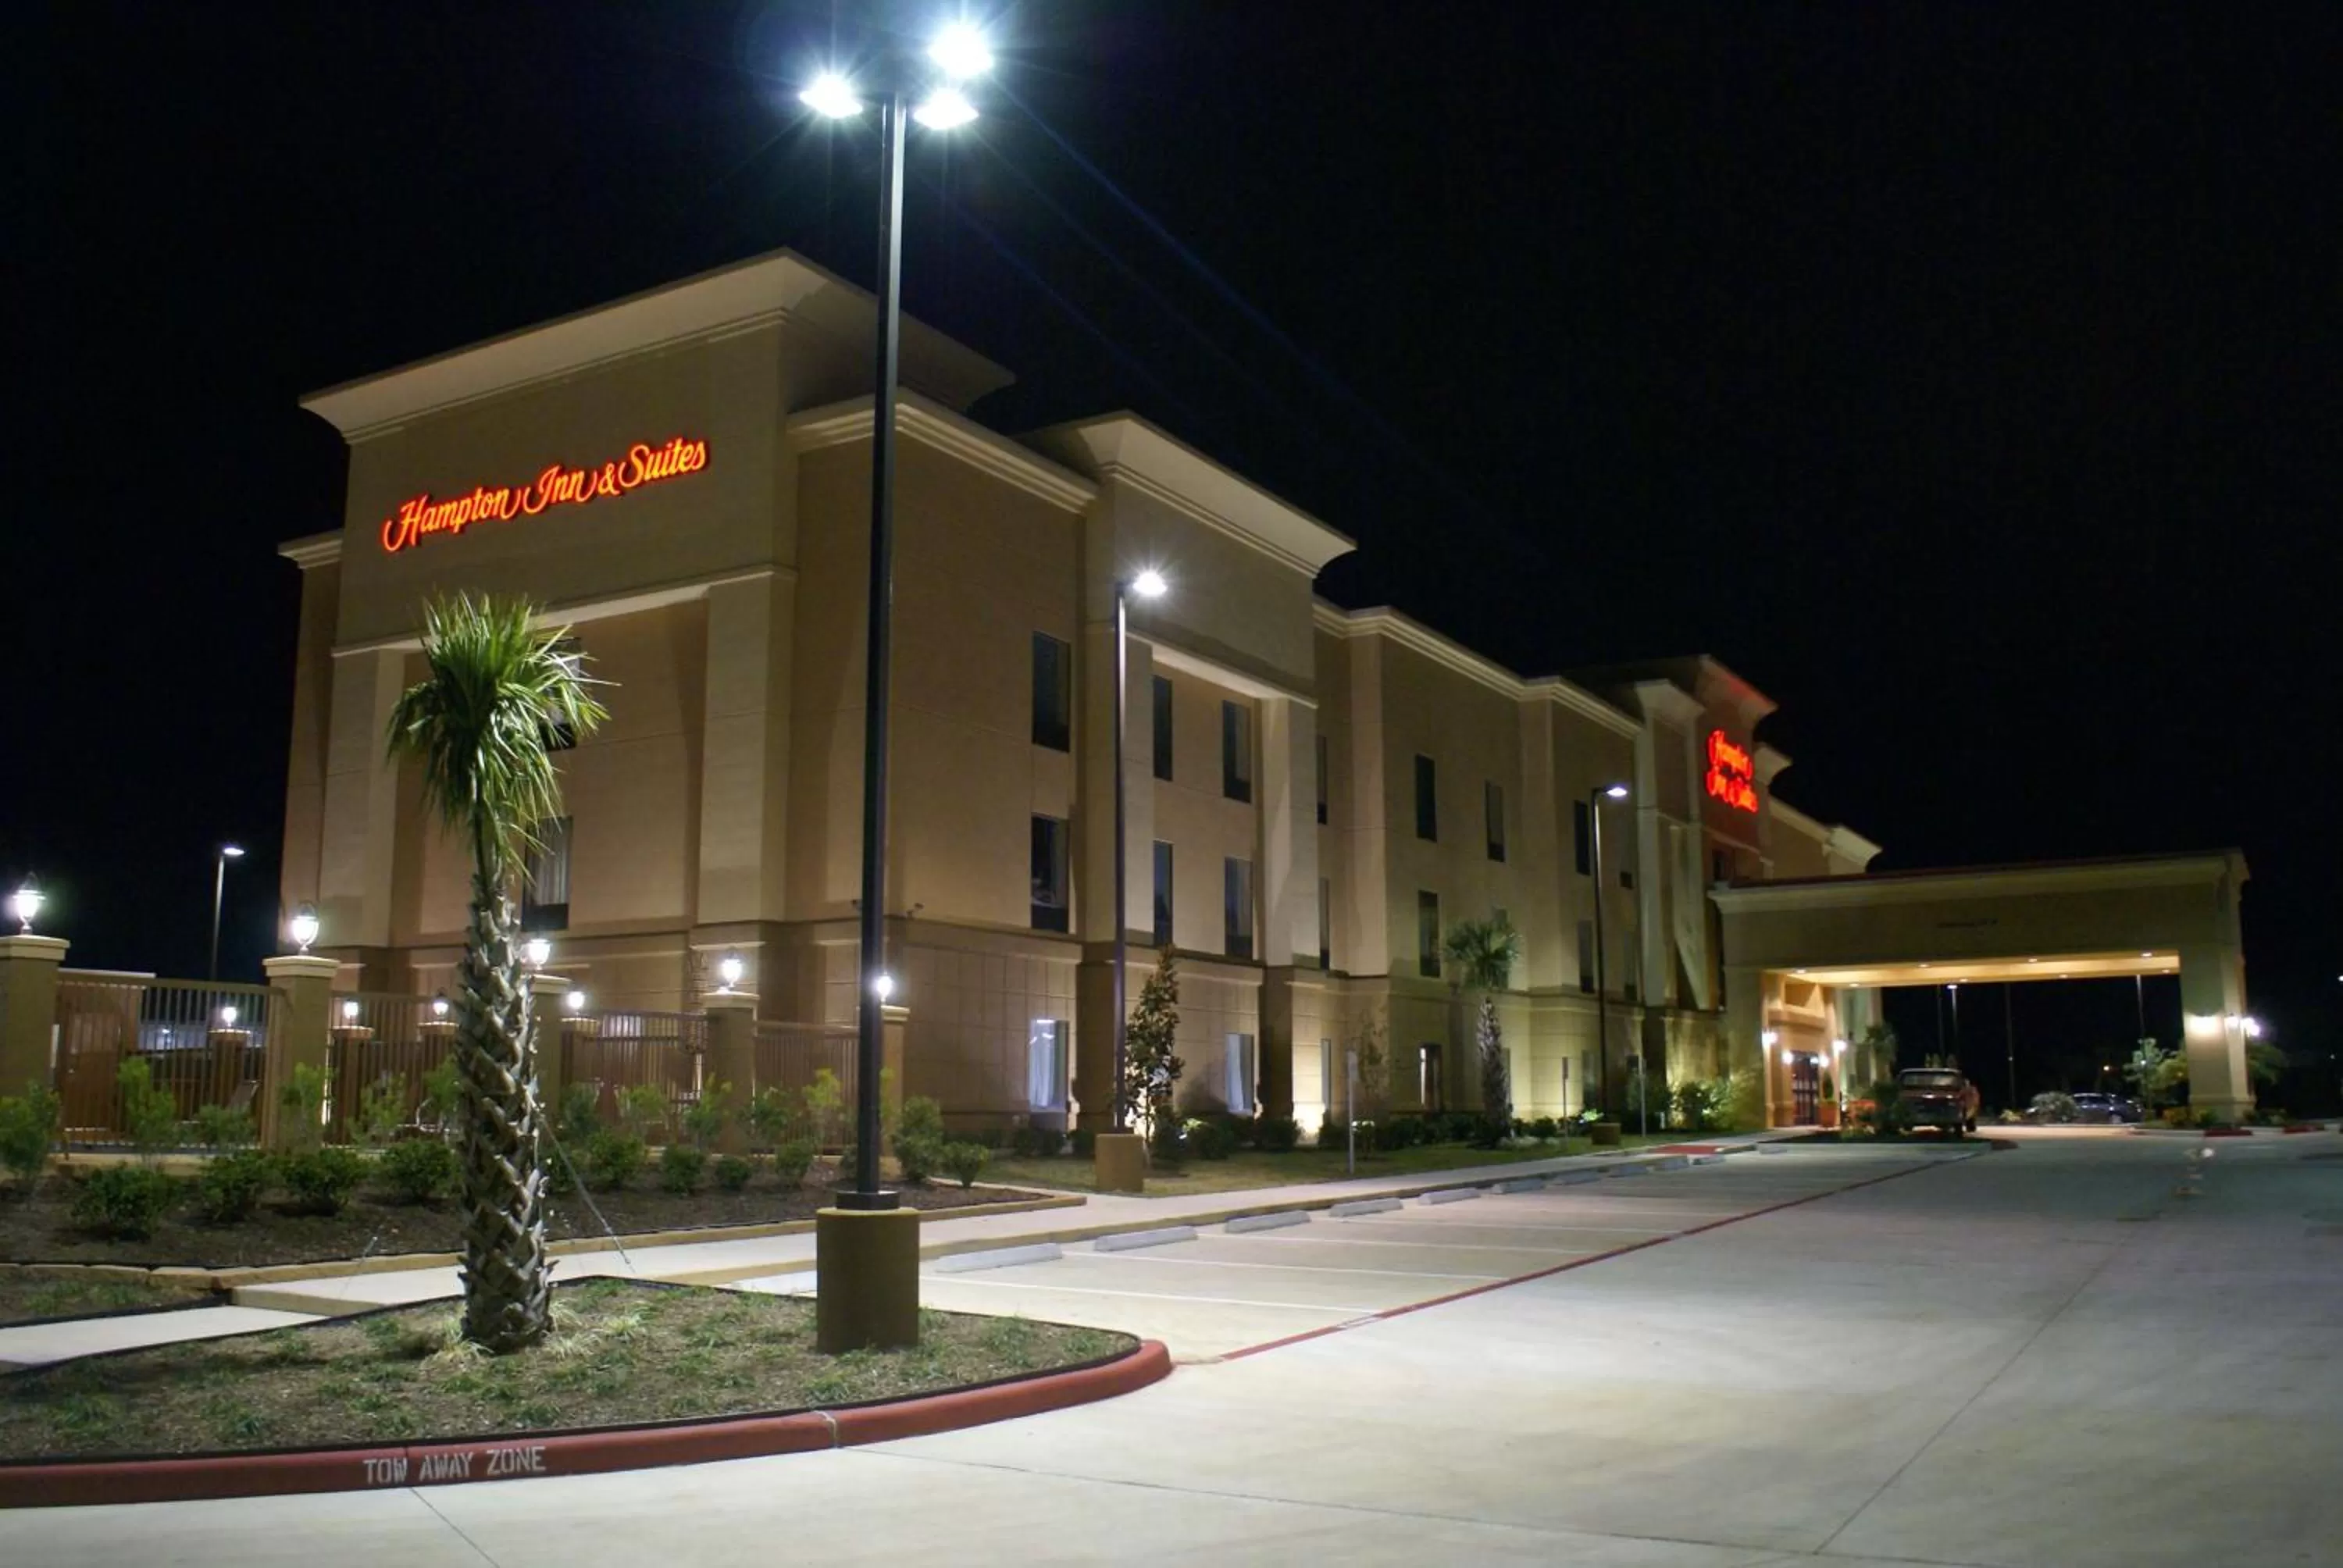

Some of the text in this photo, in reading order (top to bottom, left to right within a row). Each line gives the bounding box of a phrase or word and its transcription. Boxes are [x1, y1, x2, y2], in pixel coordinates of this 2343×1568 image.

[383, 437, 706, 551] Hampton Inn & Suites
[363, 1446, 547, 1484] TOW AWAY ZONE
